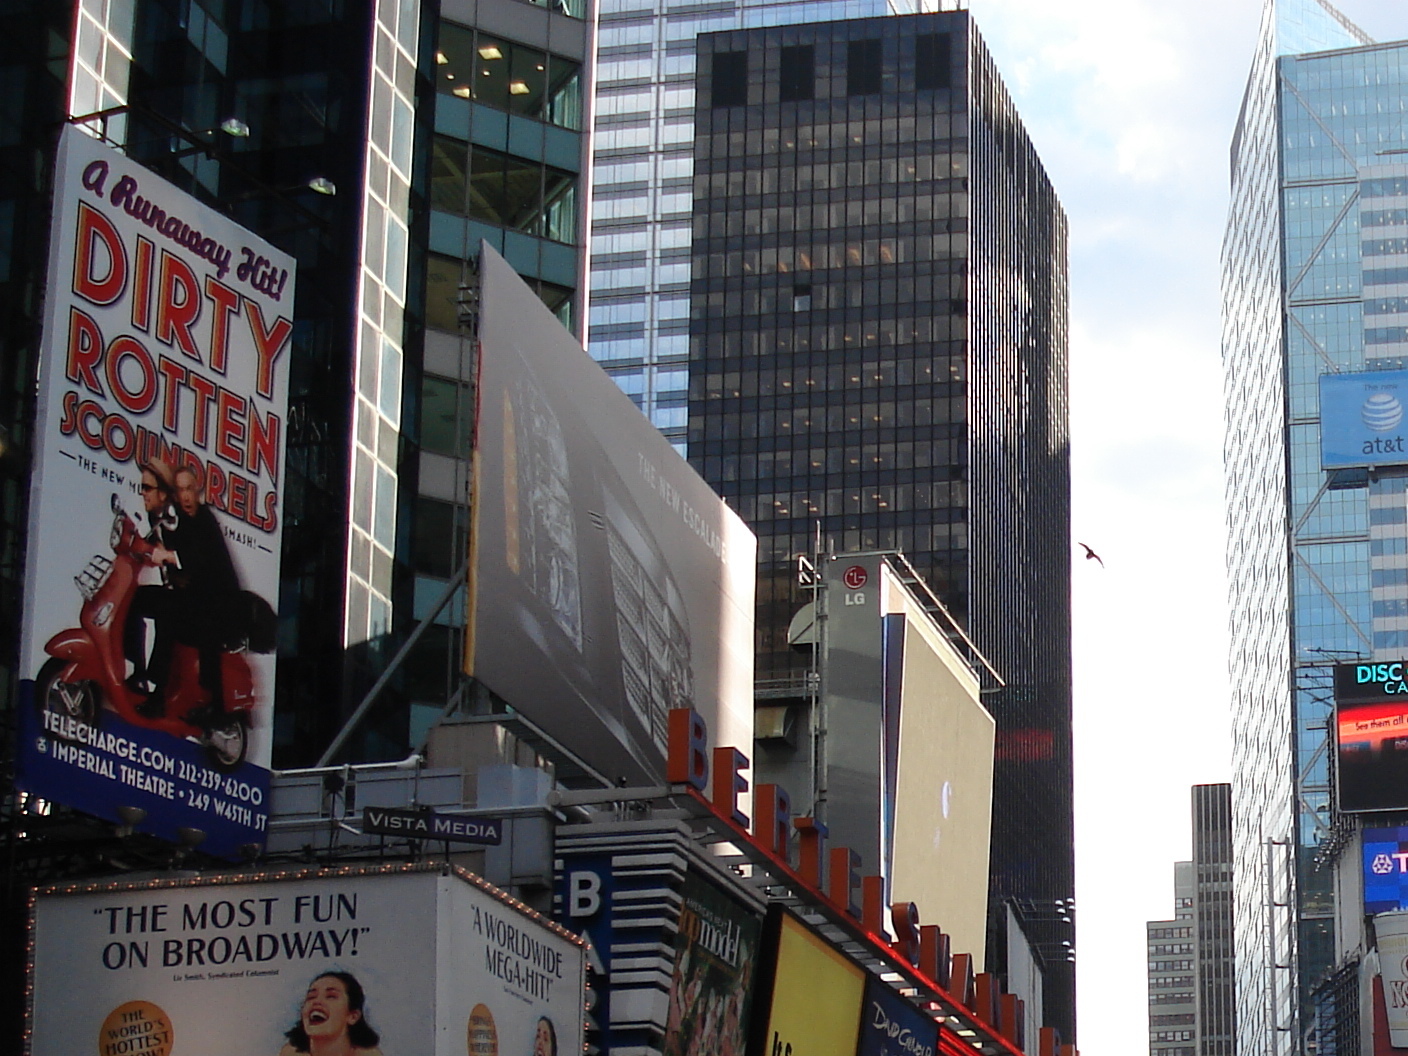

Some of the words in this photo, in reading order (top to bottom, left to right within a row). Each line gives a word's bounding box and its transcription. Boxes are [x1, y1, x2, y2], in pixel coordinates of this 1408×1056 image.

[82, 159, 111, 199] A
[111, 175, 231, 279] Runaway
[236, 246, 288, 301] Hit!
[72, 199, 293, 400] DIRTY
[65, 305, 281, 488] ROTTEN
[1364, 383, 1379, 392] The
[1362, 436, 1405, 455] at&t
[78, 454, 98, 475] THE
[101, 465, 126, 486] NEW
[638, 452, 656, 490] THE
[660, 476, 680, 514] NEW
[845, 593, 865, 606] LG
[1355, 722, 1369, 732] See
[1370, 719, 1391, 729] them
[1392, 716, 1404, 726] all
[43, 709, 175, 776] TELECHARGE.COM
[52, 740, 117, 780] IMPERIAL
[120, 764, 175, 800] THEATRE
[188, 789, 210, 812] 249
[254, 814, 268, 832] ST
[368, 812, 428, 832] VISTA
[434, 818, 498, 839] MEDIA
[182, 897, 280, 931] MOST
[294, 893, 358, 924] FUN
[102, 941, 150, 971] ON
[484, 912, 563, 979] WORLDWIDE
[121, 1009, 146, 1025] THE
[105, 1031, 170, 1056] HOTTEST
